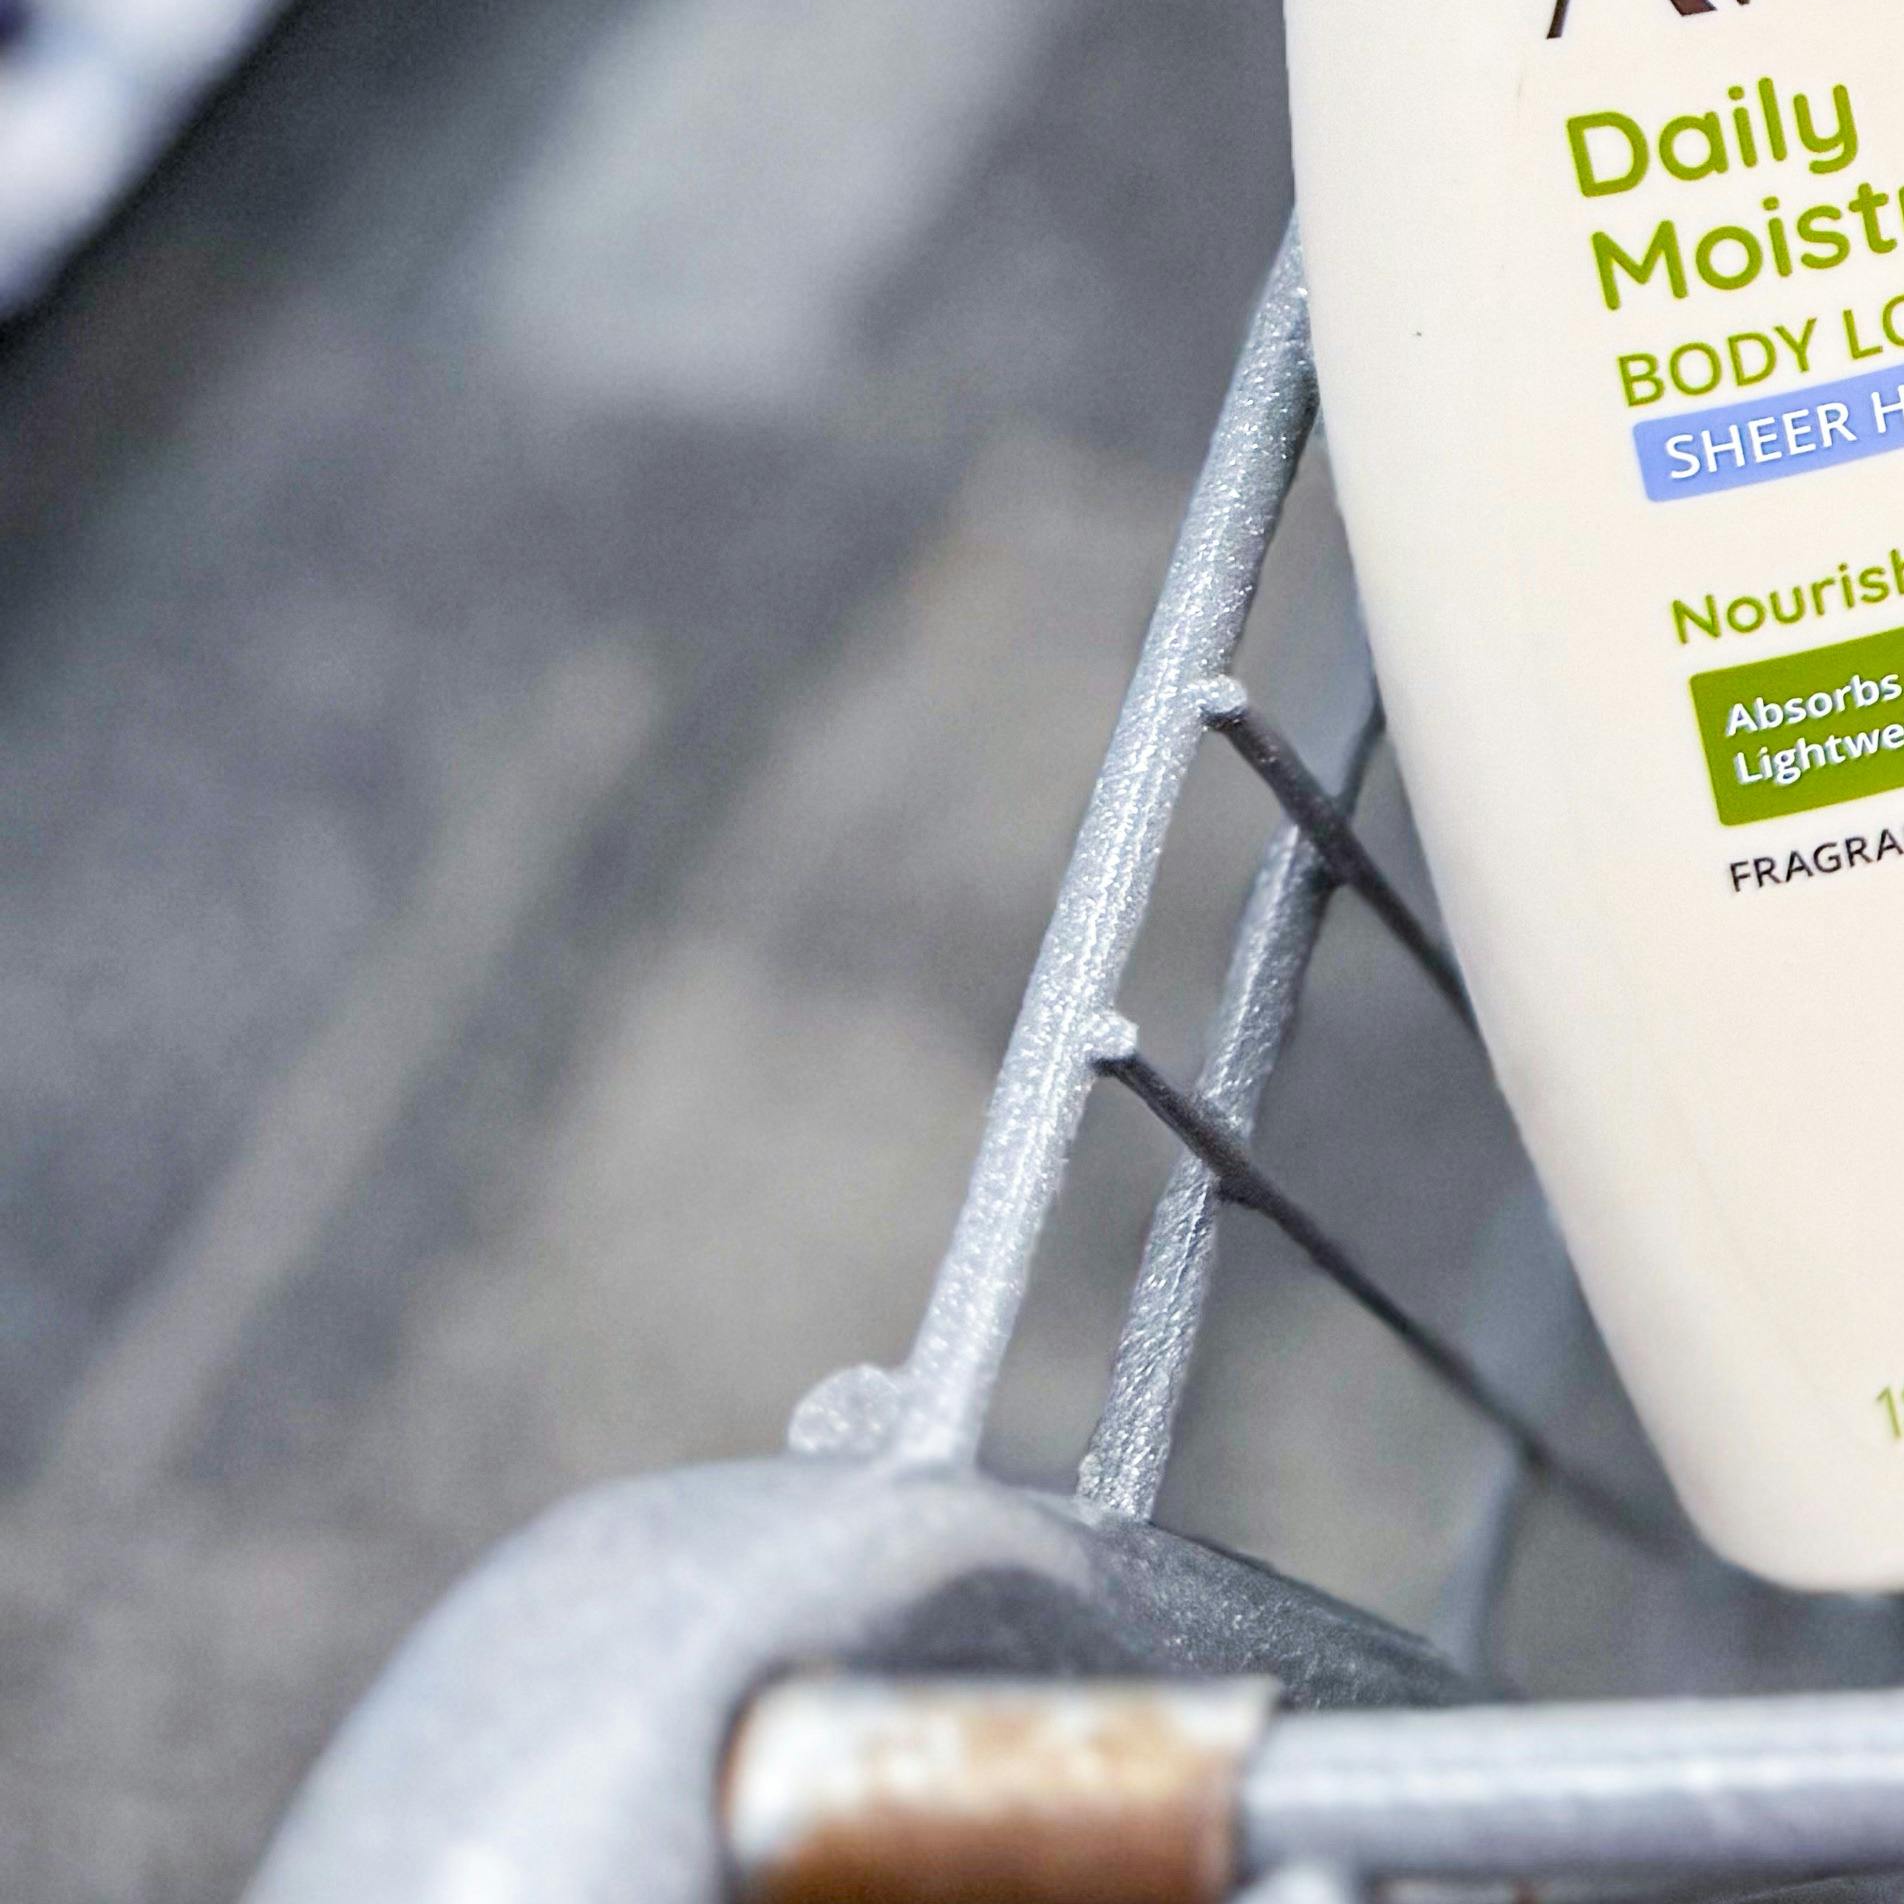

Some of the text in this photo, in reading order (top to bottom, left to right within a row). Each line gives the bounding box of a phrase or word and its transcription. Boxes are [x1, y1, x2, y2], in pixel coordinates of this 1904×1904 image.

[1566, 77, 1858, 198] Daily
[1617, 319, 1819, 407] BODY
[1666, 401, 1856, 479] SHEER
[1725, 673, 1903, 738] Absorbs
